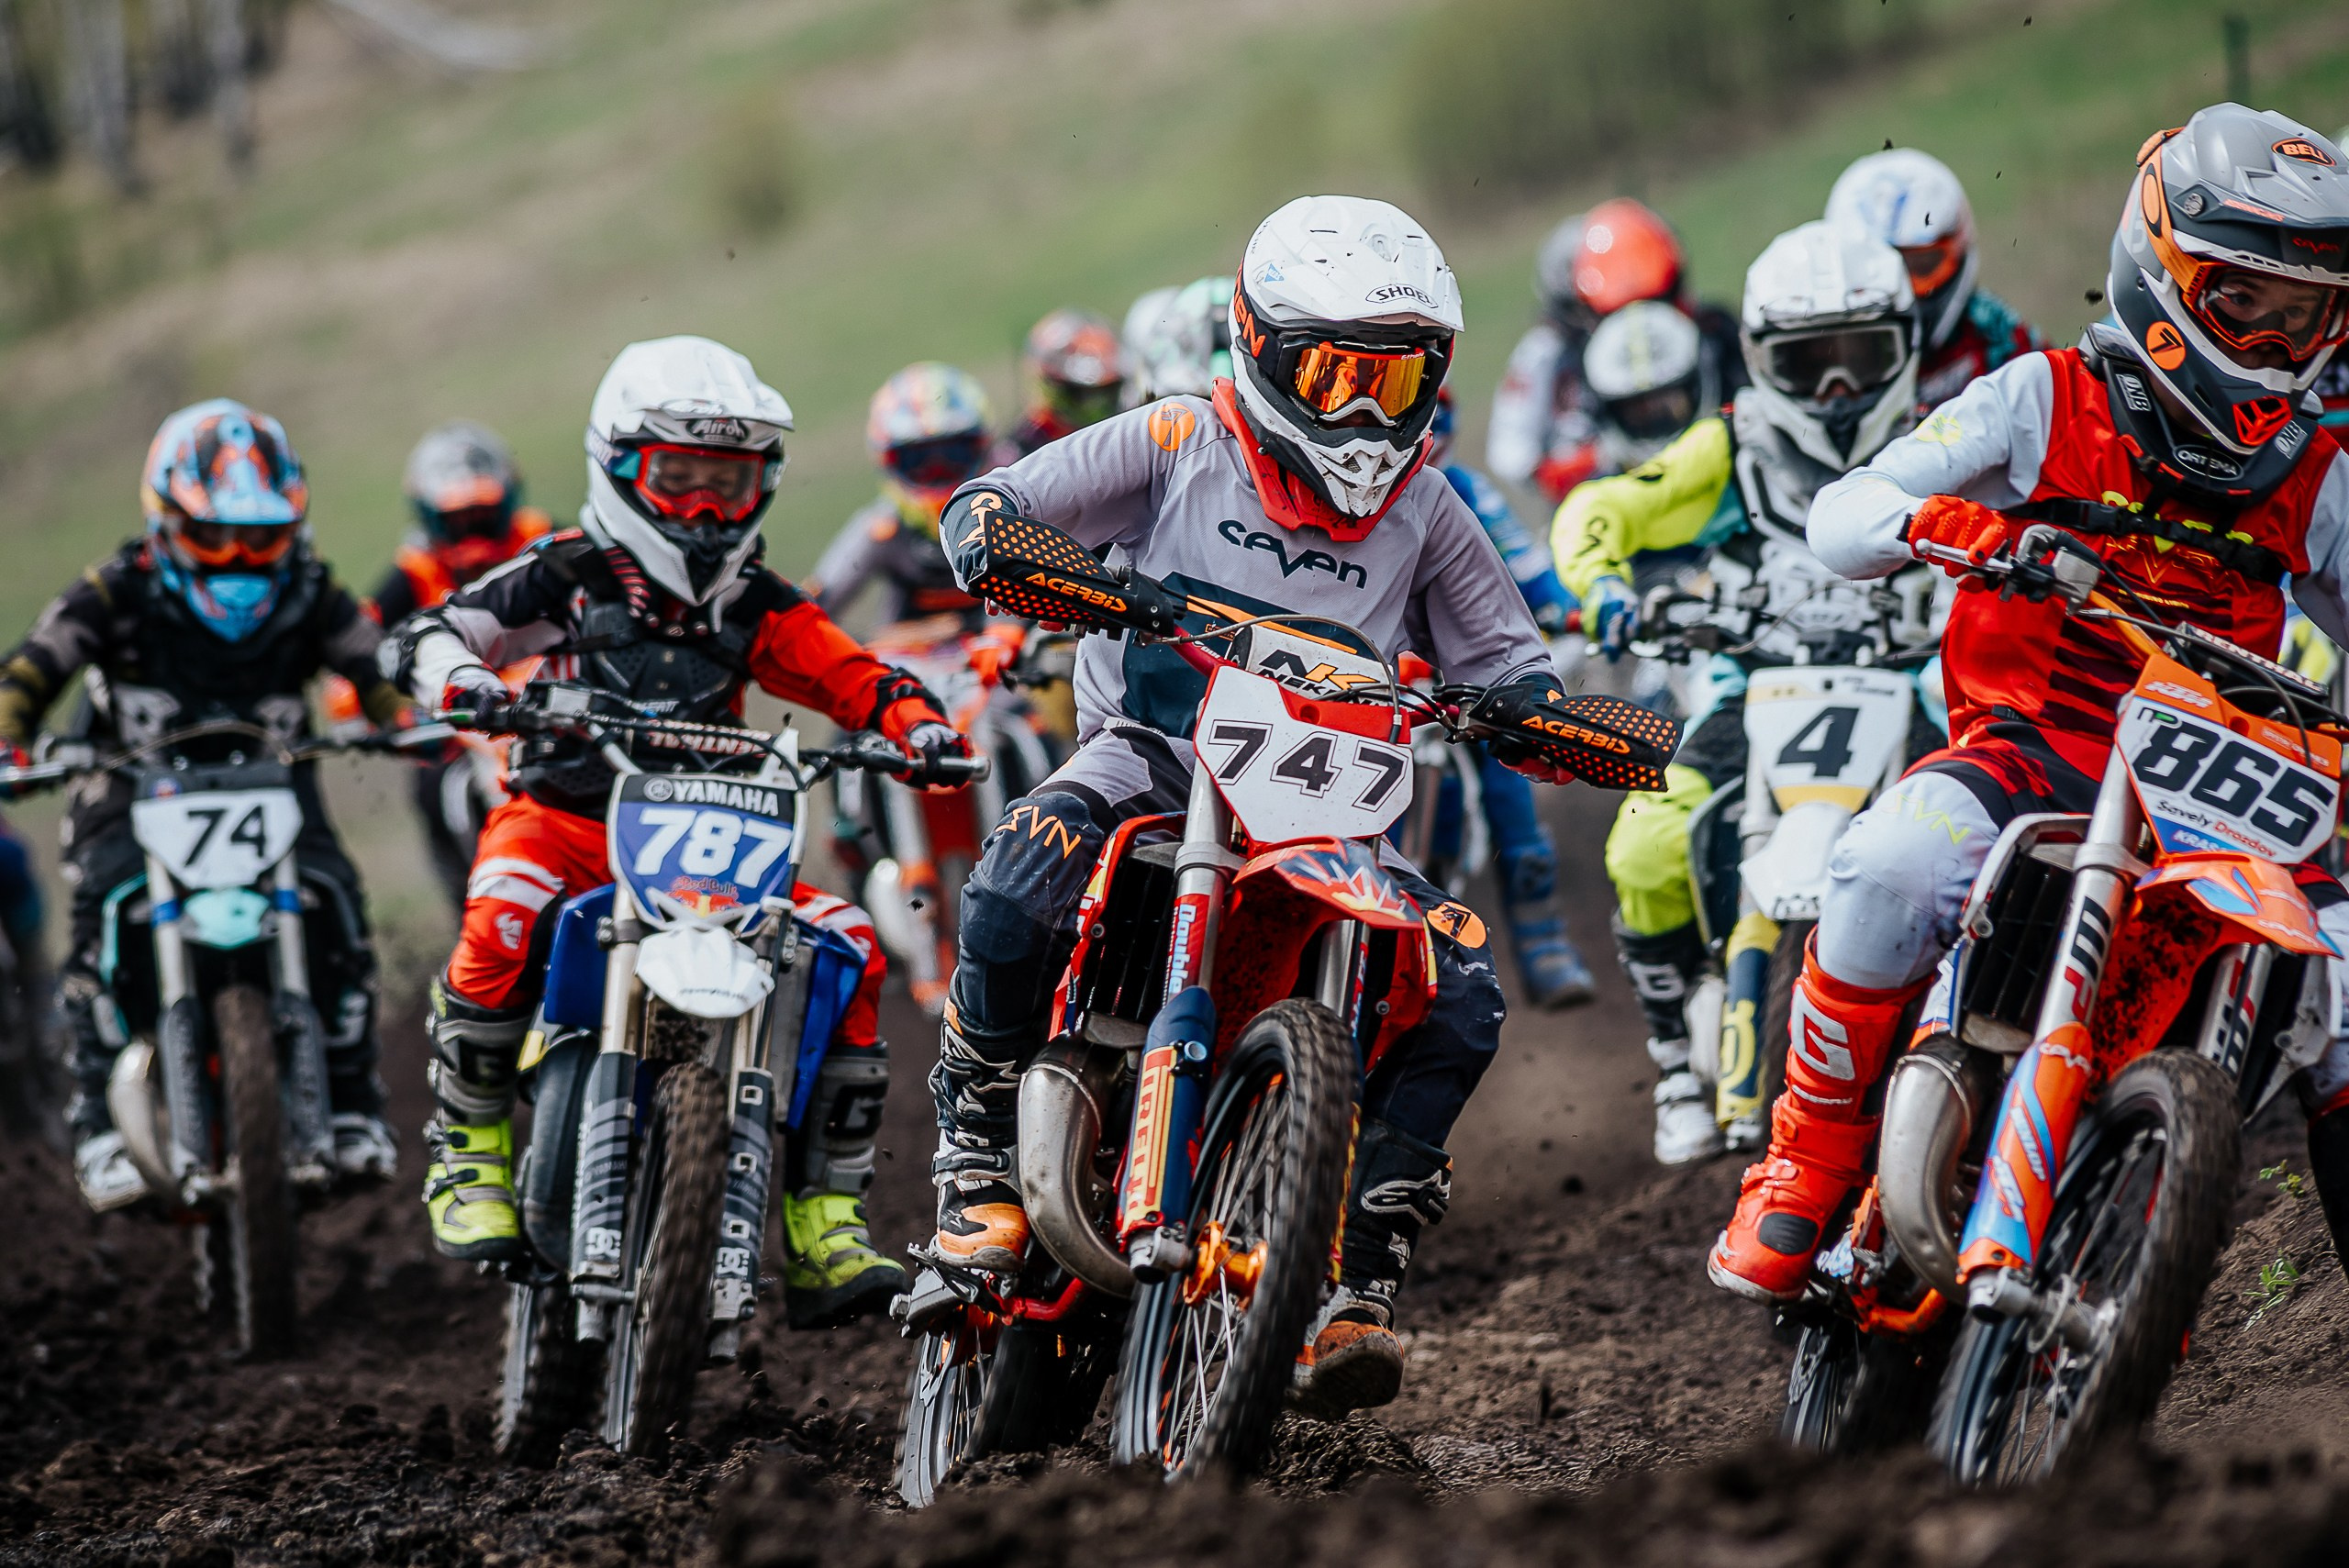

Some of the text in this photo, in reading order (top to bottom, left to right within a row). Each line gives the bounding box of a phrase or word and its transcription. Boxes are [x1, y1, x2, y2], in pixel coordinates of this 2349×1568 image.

[2282, 143, 2328, 163] BELL
[1375, 285, 1433, 306] SHOEI
[692, 418, 745, 438] Airoh
[1218, 519, 1368, 590] seven
[1025, 572, 1128, 613] ACERBIS
[2193, 627, 2323, 693] RENTHAL
[2143, 680, 2214, 709] KTM
[1208, 718, 1409, 813] 747
[1520, 716, 1631, 755] ACERBIS
[1776, 706, 1860, 778] 4
[672, 779, 779, 817] YAMAHA
[2132, 719, 2335, 848] 865
[184, 804, 267, 869] 74
[633, 806, 794, 889] 787
[2157, 799, 2277, 858] Savely Drozdov
[1790, 984, 1856, 1082] G
